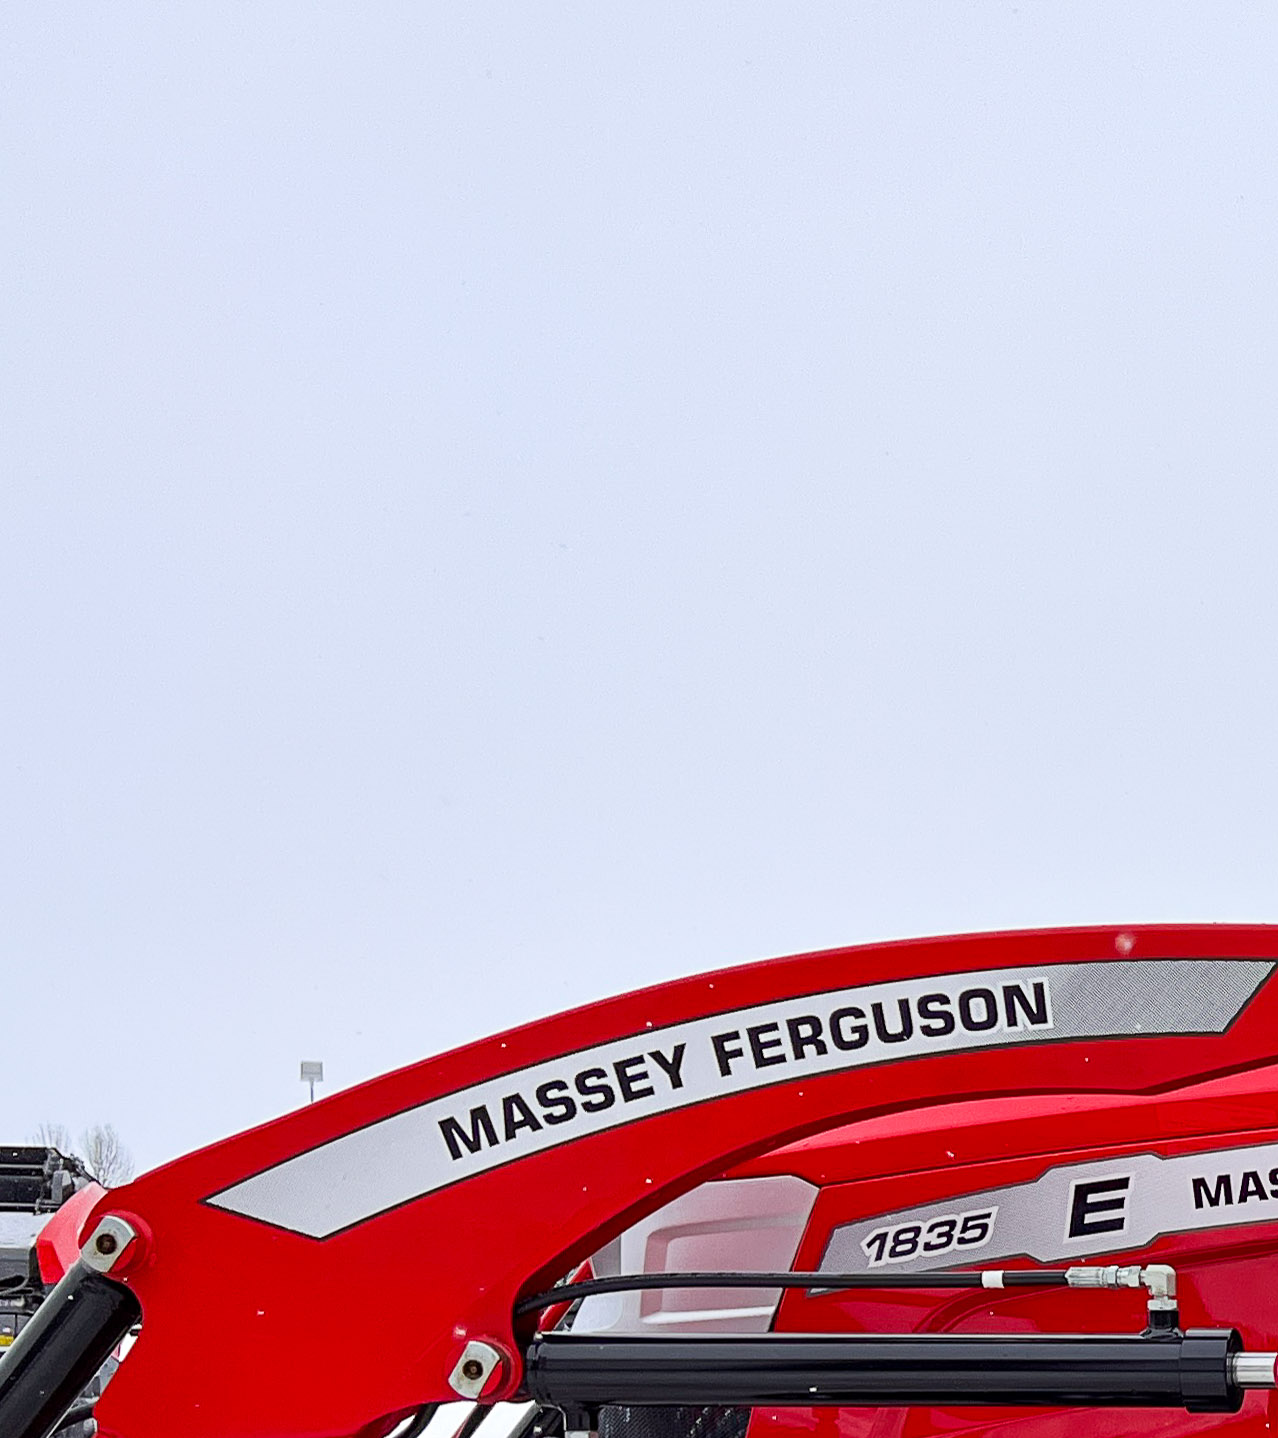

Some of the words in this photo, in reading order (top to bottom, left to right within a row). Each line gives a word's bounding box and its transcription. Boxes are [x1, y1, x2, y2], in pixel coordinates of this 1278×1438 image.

[437, 1043, 687, 1161] MASSEY
[710, 981, 1049, 1077] FERGUSON
[864, 1212, 994, 1265] 1835
[1068, 1176, 1130, 1239] E
